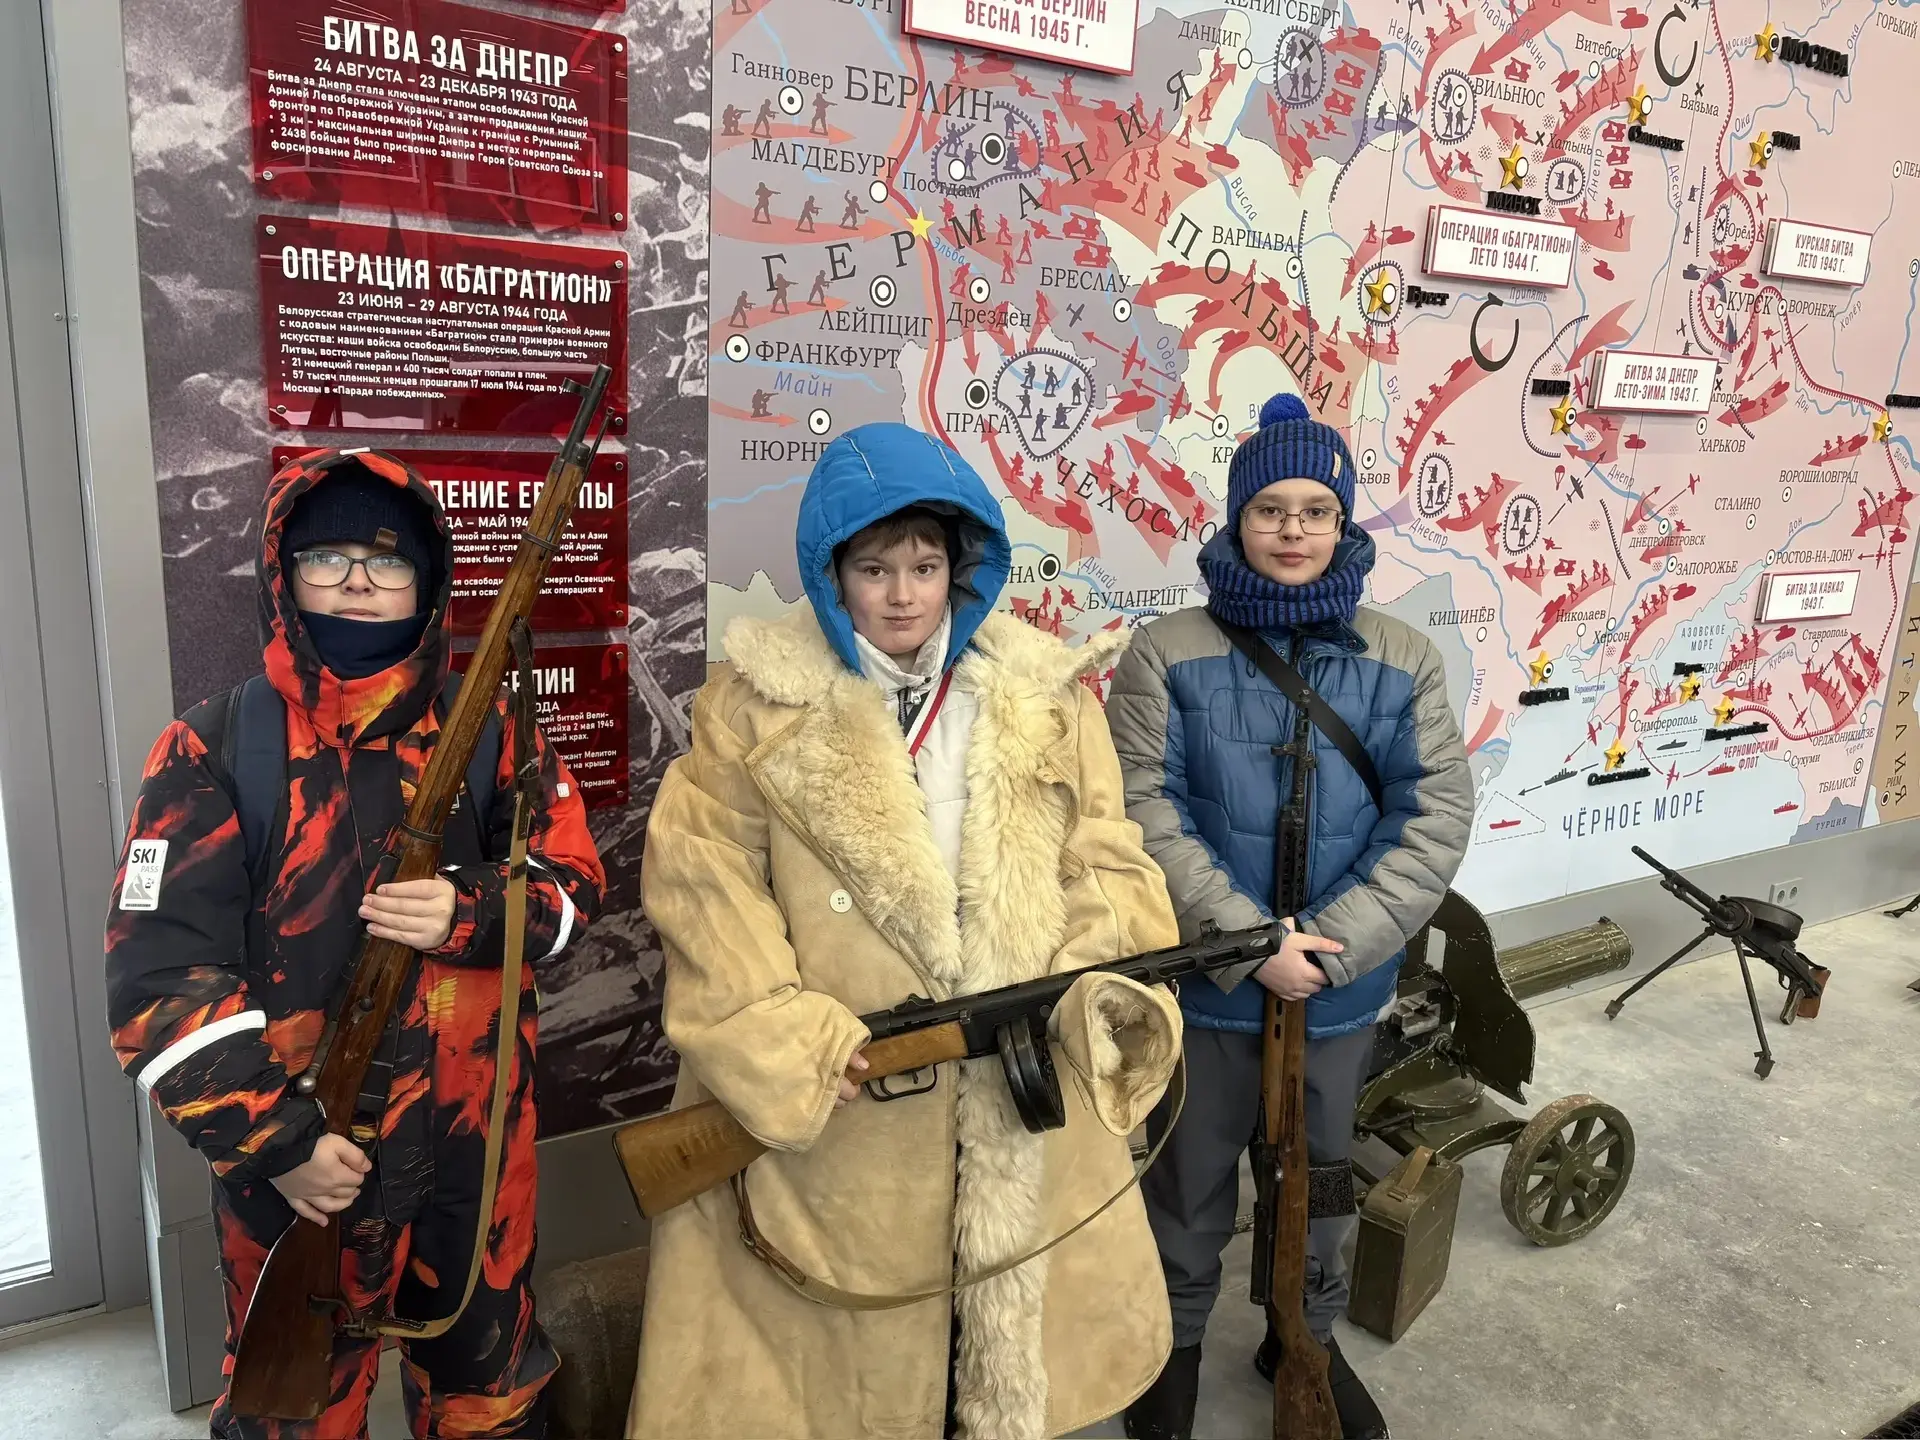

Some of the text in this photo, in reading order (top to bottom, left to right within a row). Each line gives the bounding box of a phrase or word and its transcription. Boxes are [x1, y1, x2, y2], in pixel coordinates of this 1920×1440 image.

[965, 0, 1089, 48] ВЕСНА 1945 Г.
[1178, 20, 1242, 48] ДАНЦИГ
[1875, 11, 1919, 39] ГОРЬКИЙ
[1388, 18, 1425, 59] Неман
[1574, 33, 1625, 61] Витебск
[1846, 23, 1860, 50] Ока
[323, 16, 569, 87] БИТВА ЗА ДНЕПР
[1519, 28, 1547, 72] Двина
[1778, 35, 1850, 78] МОСКВА
[314, 58, 577, 112] 24 АВГУСТА 23 ДЕКАБРЯ 1943 ГОДА
[731, 52, 834, 94] Ганновер
[267, 70, 588, 127] Битва Днепр стала ключевым этапом освобождения Красной
[844, 65, 994, 123] БЕРЛИН
[1474, 77, 1546, 109] ВИЛЬНЮС
[1680, 93, 1720, 117] Вязьма
[268, 84, 554, 134] Армией Левобережной Украины, продвижения
[317, 118, 393, 137] максимальная
[338, 107, 582, 150] Правобережной Румынией.
[1734, 114, 1751, 133] Ока
[271, 140, 395, 164] форсирование Днепра.
[281, 127, 559, 173] 2438 Советского
[1546, 132, 1594, 156] Хатынь
[751, 137, 900, 179] МАГДЕБУРГ
[761, 69, 1193, 292] ГЕРМАНИЯ
[1587, 147, 1605, 202] Днепр
[1229, 175, 1259, 223] Висла
[1211, 225, 1296, 254] ВАРШАВА
[1440, 221, 1572, 255] ОПЕРАЦИЯ «БАГРАТИОН»
[1728, 222, 1751, 240] Орёл
[931, 236, 966, 266] Эльба
[1795, 233, 1854, 257] КУРСКАЯ БИТВА
[1469, 247, 1539, 273] ЛЕТО 1944 Г.
[1797, 252, 1818, 269] ЛЕТО
[1819, 254, 1837, 271] 1943
[282, 245, 611, 304] ОПЕРАЦИЯ «БАГРАТИОН»
[1039, 266, 1131, 295] БРЕСЛАУ
[338, 292, 568, 322] 23 ИЮНЯ 29 АВГУСТА 1944 ГОДА
[1166, 213, 1334, 415] ПОЛЬША
[1727, 291, 1773, 316] КУРСК
[1788, 299, 1838, 318] ВОРОНЕЖ
[278, 305, 610, 337] Белорусская стратегическая наступательная операция Красной Армии
[818, 305, 934, 339] ЛЕЙПЦИГ
[945, 301, 1033, 331] Дрезден
[425, 328, 487, 341] «Багратион»
[463, 344, 520, 356] Белоруссию,
[755, 340, 901, 370] ФРАНКФУРТ
[1155, 335, 1180, 384] Одер
[773, 370, 834, 398] Майн
[1625, 365, 1698, 384] БИТВА ЗА ДНЕПР
[1386, 374, 1401, 404] Буг
[1614, 382, 1666, 400] ЛЕТО-ЗИМА
[1670, 387, 1690, 402] 1943
[945, 412, 1011, 435] ПРАГА
[1698, 438, 1747, 454] ХАРЬКОВ
[1607, 463, 1635, 488] Днепр
[1778, 470, 1859, 485] ВОРОШИЛОВГРАД
[1057, 456, 1218, 546] ЧЕХОСЛО
[1714, 496, 1762, 512] СТАЛИНО
[478, 514, 507, 528] МАЙ
[482, 532, 608, 541] войны Азии
[1408, 517, 1449, 550] Днестр
[1628, 534, 1707, 549] ДНЕПРОПЕТРОВСК
[565, 553, 598, 563] Красной
[1675, 559, 1739, 576] ЗАПОРОЖЬЕ
[1775, 548, 1855, 566] РОСТОВ-НА-ДОНУ
[545, 575, 615, 584] смерти Освенцим.
[1081, 556, 1118, 590] Дунай
[1087, 587, 1189, 612] БУДАПЕШТ
[1785, 580, 1845, 597] БИТВА ЗА КАВКАЗ
[1800, 596, 1817, 611] 1943
[1428, 606, 1496, 627] КИШИНЁВ
[1555, 609, 1607, 623] Николаев
[1593, 629, 1632, 647] Херсон
[1681, 624, 1726, 639] АЗОВСКОЕ
[1802, 628, 1849, 642] Ставрополь
[1690, 638, 1714, 652] МОРЕ
[1701, 658, 1754, 675] КРАСНОДАР
[1471, 668, 1486, 707] Прут
[547, 720, 614, 734] рейха 1945
[557, 712, 584, 722] битвой
[1633, 714, 1698, 737] Симферополь
[1723, 737, 1779, 758] ЧЕРНОМОРСКИЙ
[1812, 727, 1876, 747] ОРДЖОНИКИДЗЕ
[585, 749, 617, 759] Мелитон
[585, 759, 610, 770] крыше
[1738, 755, 1760, 770] ФЛОТ
[1791, 752, 1821, 768] Сухуми
[581, 778, 617, 789] Германии.
[1818, 776, 1858, 795] ТБИЛИСИ
[1885, 774, 1903, 788] РИМ
[1562, 789, 1706, 840] ЧЁРНОЕ МОРЕ
[1815, 816, 1847, 831] ТУРЦИЯ
[131, 848, 157, 864] SKI
[140, 865, 159, 873] PASS
